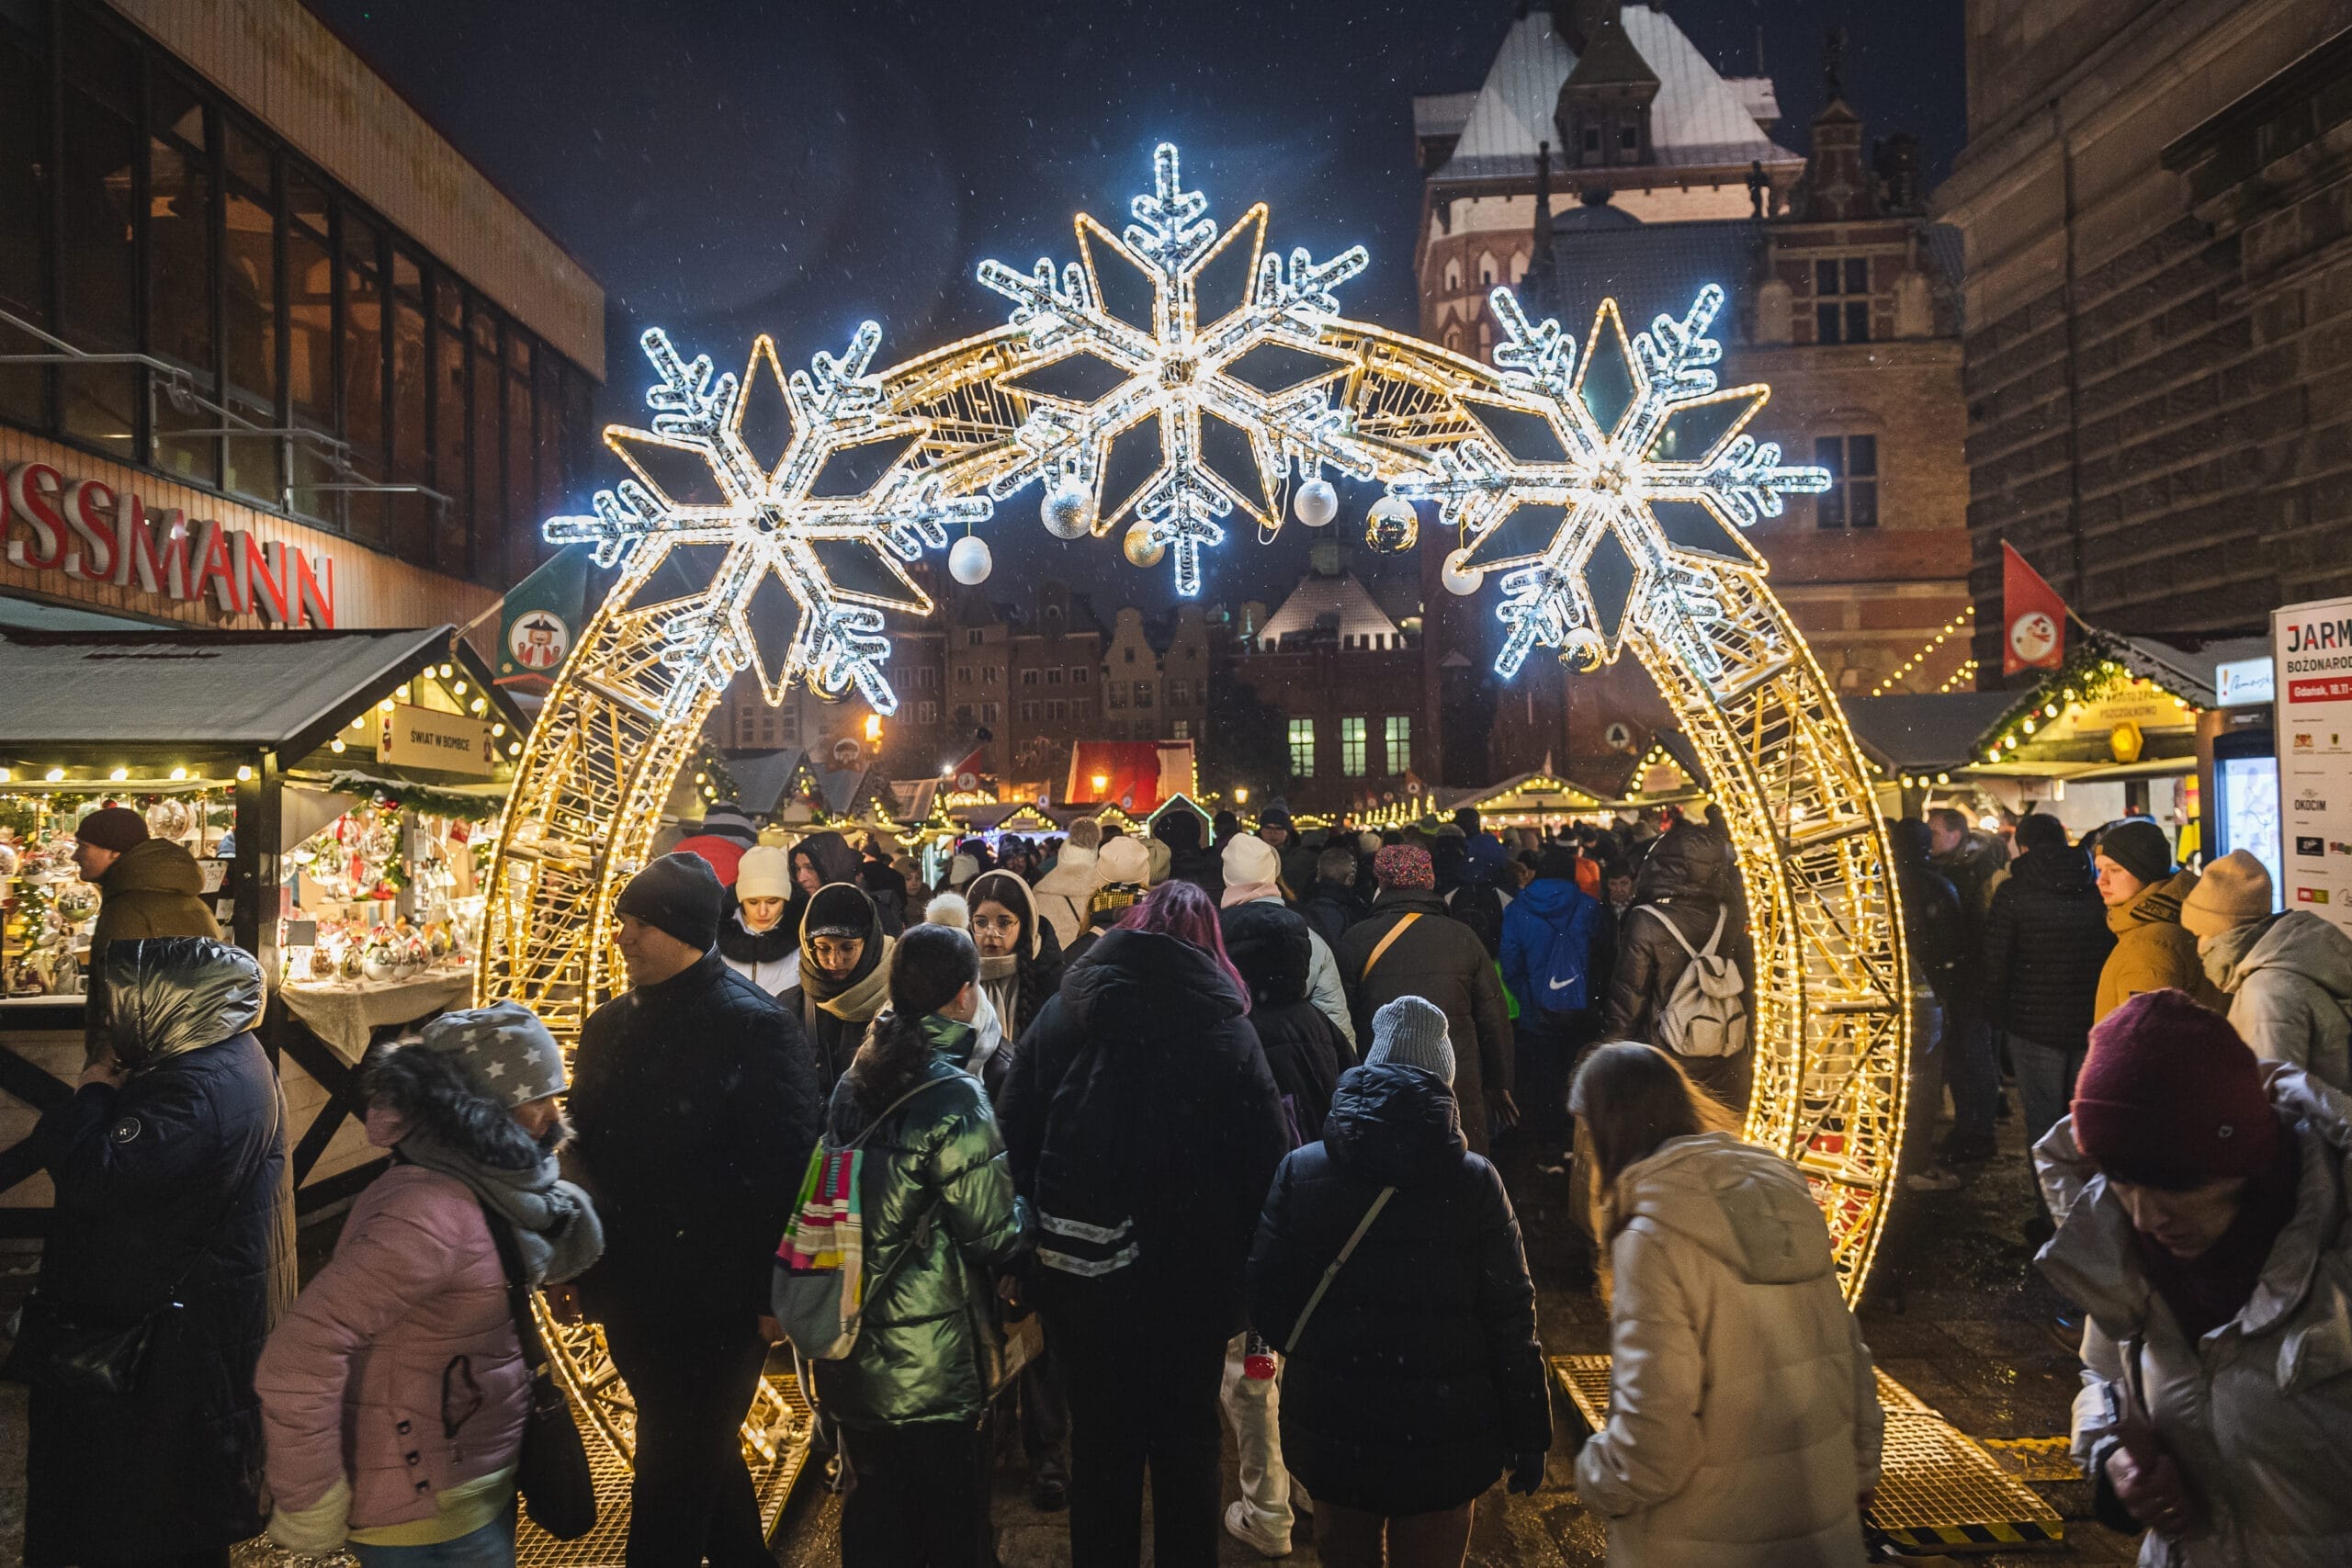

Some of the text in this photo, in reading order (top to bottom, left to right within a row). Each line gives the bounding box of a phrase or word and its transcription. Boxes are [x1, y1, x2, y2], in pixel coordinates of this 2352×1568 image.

[0, 462, 334, 630] SSMANN
[2287, 618, 2352, 653] JARM
[410, 727, 469, 751] ŚWIAT W BOMBCE
[2295, 799, 2326, 811] OKOCIM
